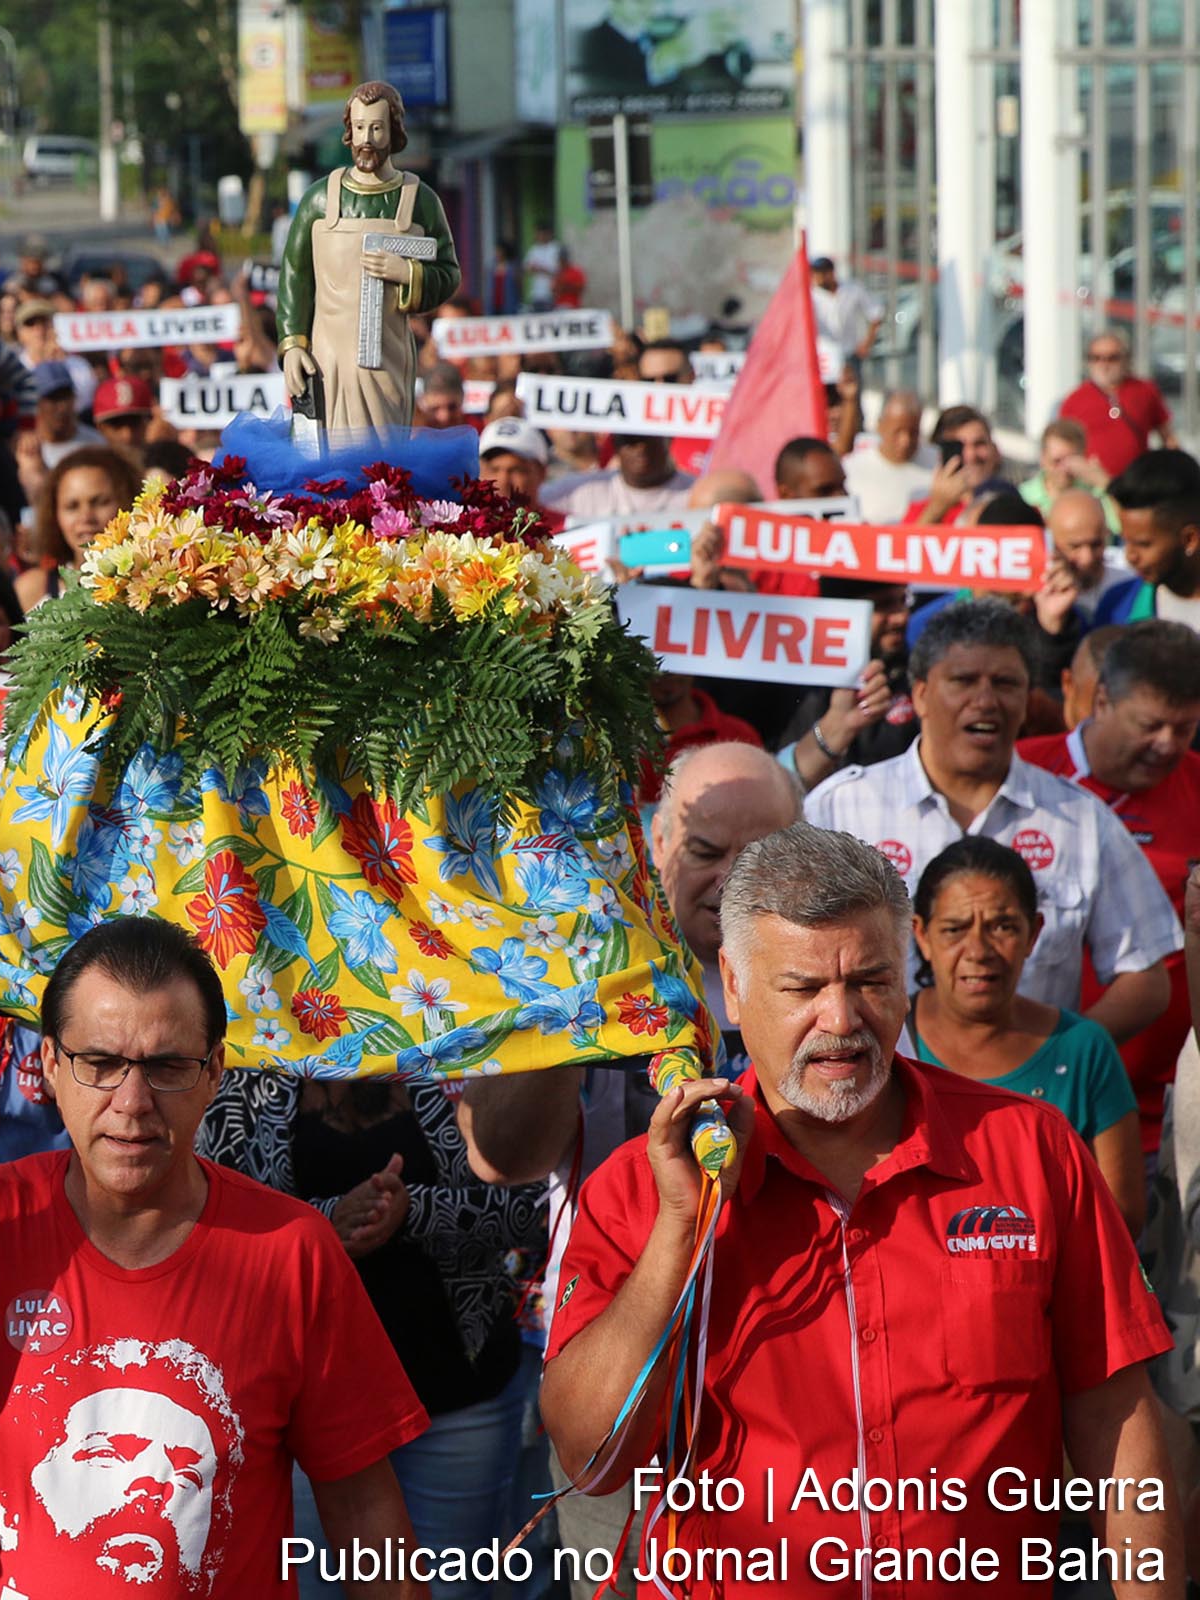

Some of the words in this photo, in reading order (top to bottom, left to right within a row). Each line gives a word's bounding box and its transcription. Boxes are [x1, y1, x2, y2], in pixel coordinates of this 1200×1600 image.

[70, 319, 138, 341] LULA
[147, 315, 225, 337] LIVRE
[447, 319, 514, 347] LULA
[523, 316, 599, 340] LIVRE
[180, 387, 269, 414] LULA
[536, 389, 627, 420] LULA
[729, 516, 860, 570] LULA
[876, 534, 1033, 580] LIVRE
[654, 606, 852, 668] LIVRE
[26, 1056, 42, 1069] LU
[16, 1298, 62, 1314] LULA
